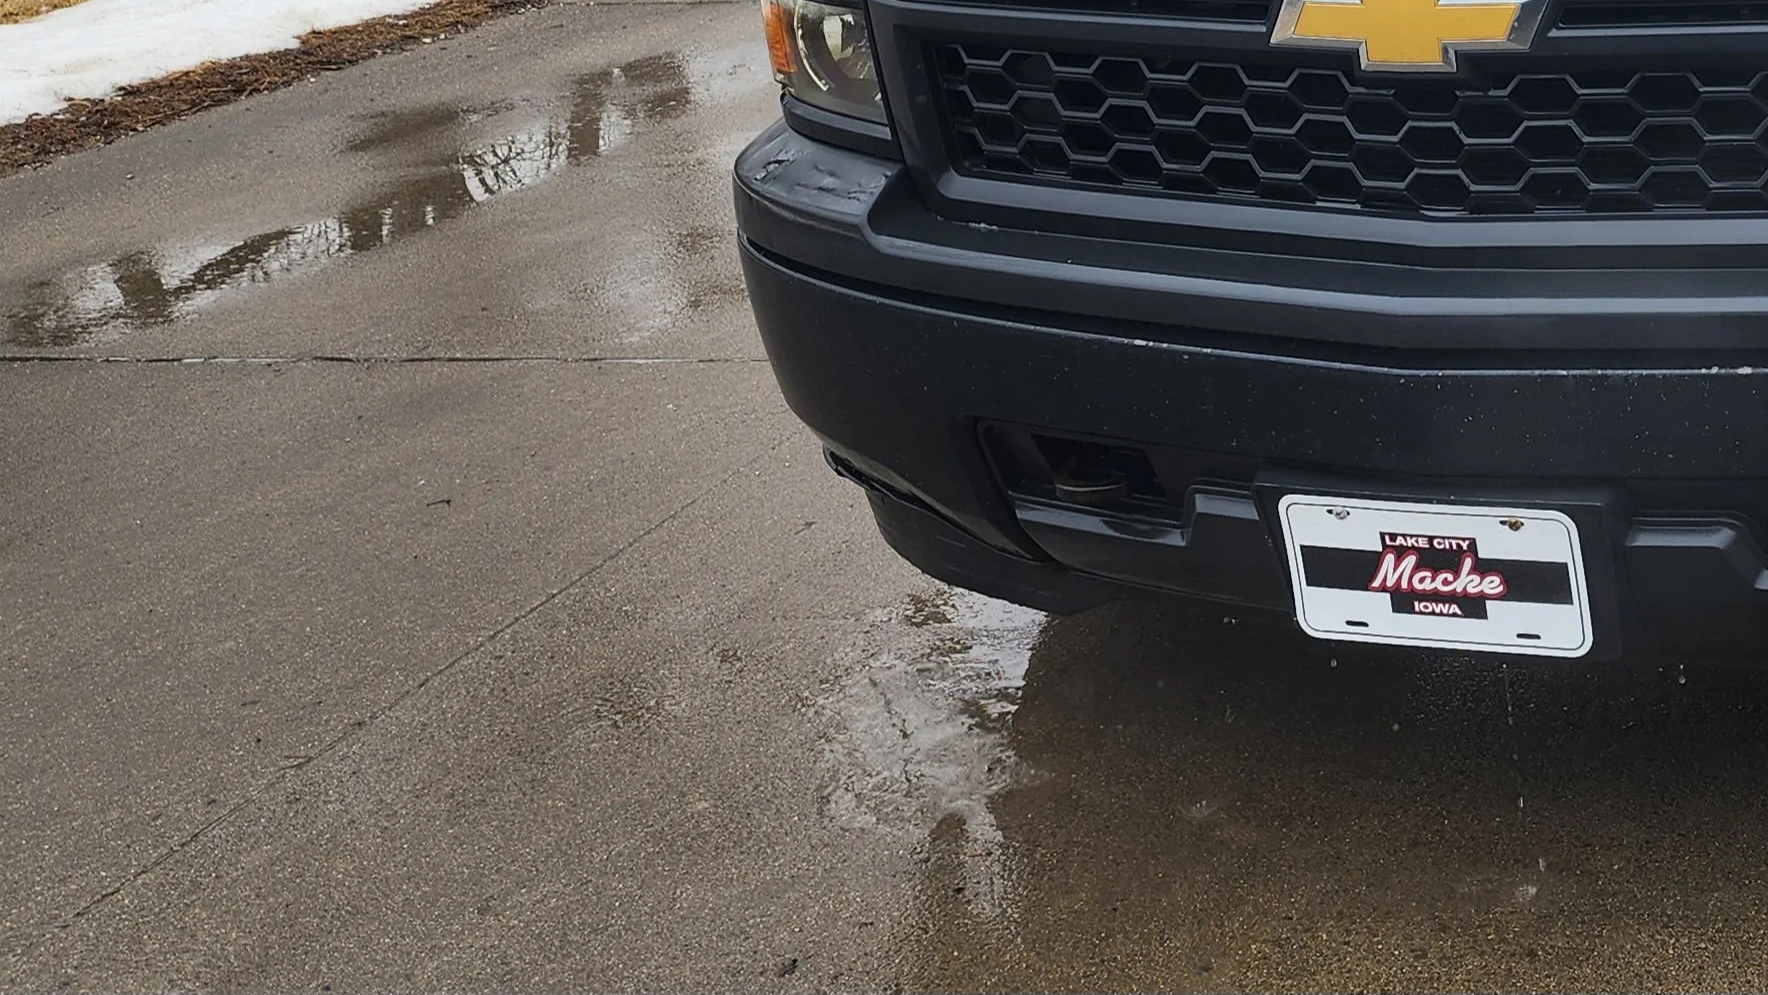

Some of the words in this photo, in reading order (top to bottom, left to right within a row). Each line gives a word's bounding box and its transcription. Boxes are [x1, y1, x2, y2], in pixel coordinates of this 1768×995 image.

[1384, 535, 1430, 549] LAKE
[1433, 537, 1471, 551] CITY
[1370, 552, 1505, 595] Macke
[1414, 601, 1462, 615] IOWA
